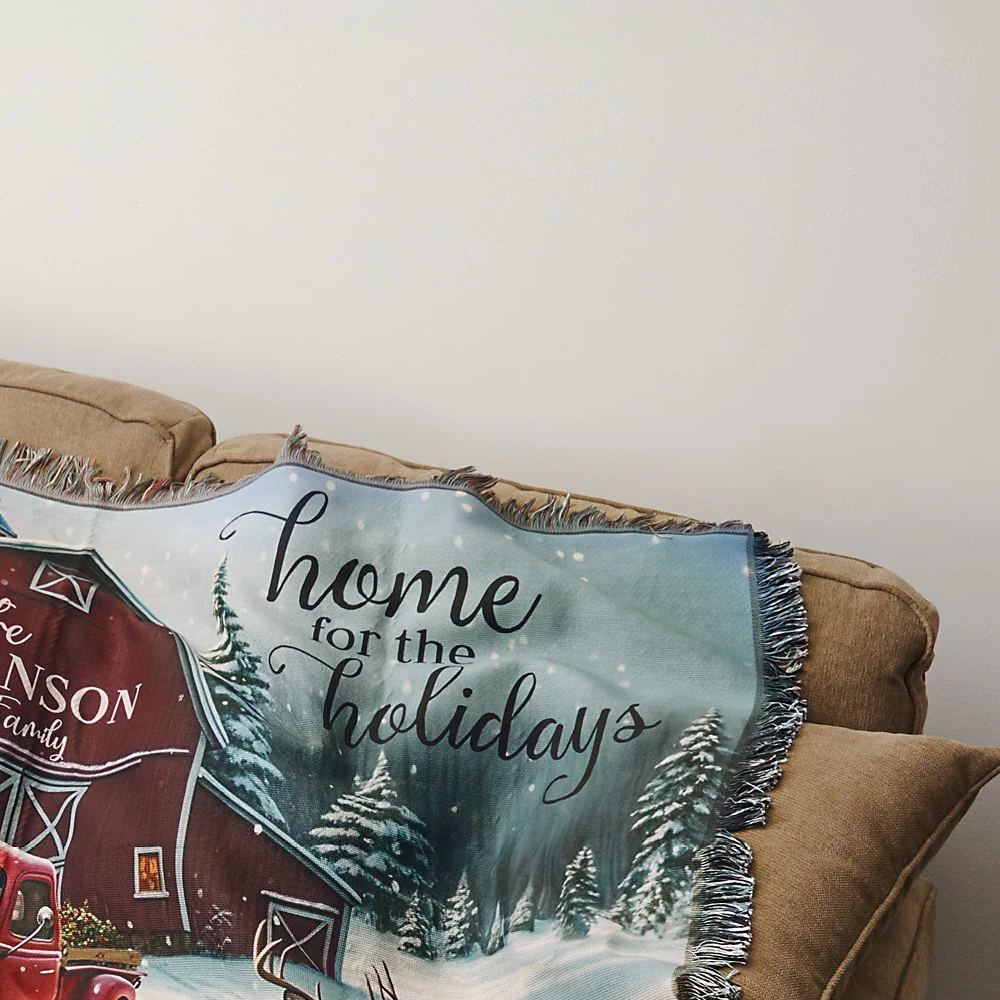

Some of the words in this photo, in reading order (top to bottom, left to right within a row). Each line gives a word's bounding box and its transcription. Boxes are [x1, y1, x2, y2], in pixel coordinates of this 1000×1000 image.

[219, 490, 542, 634] home
[311, 616, 382, 658] for
[395, 628, 476, 665] the
[267, 644, 662, 804] holidays
